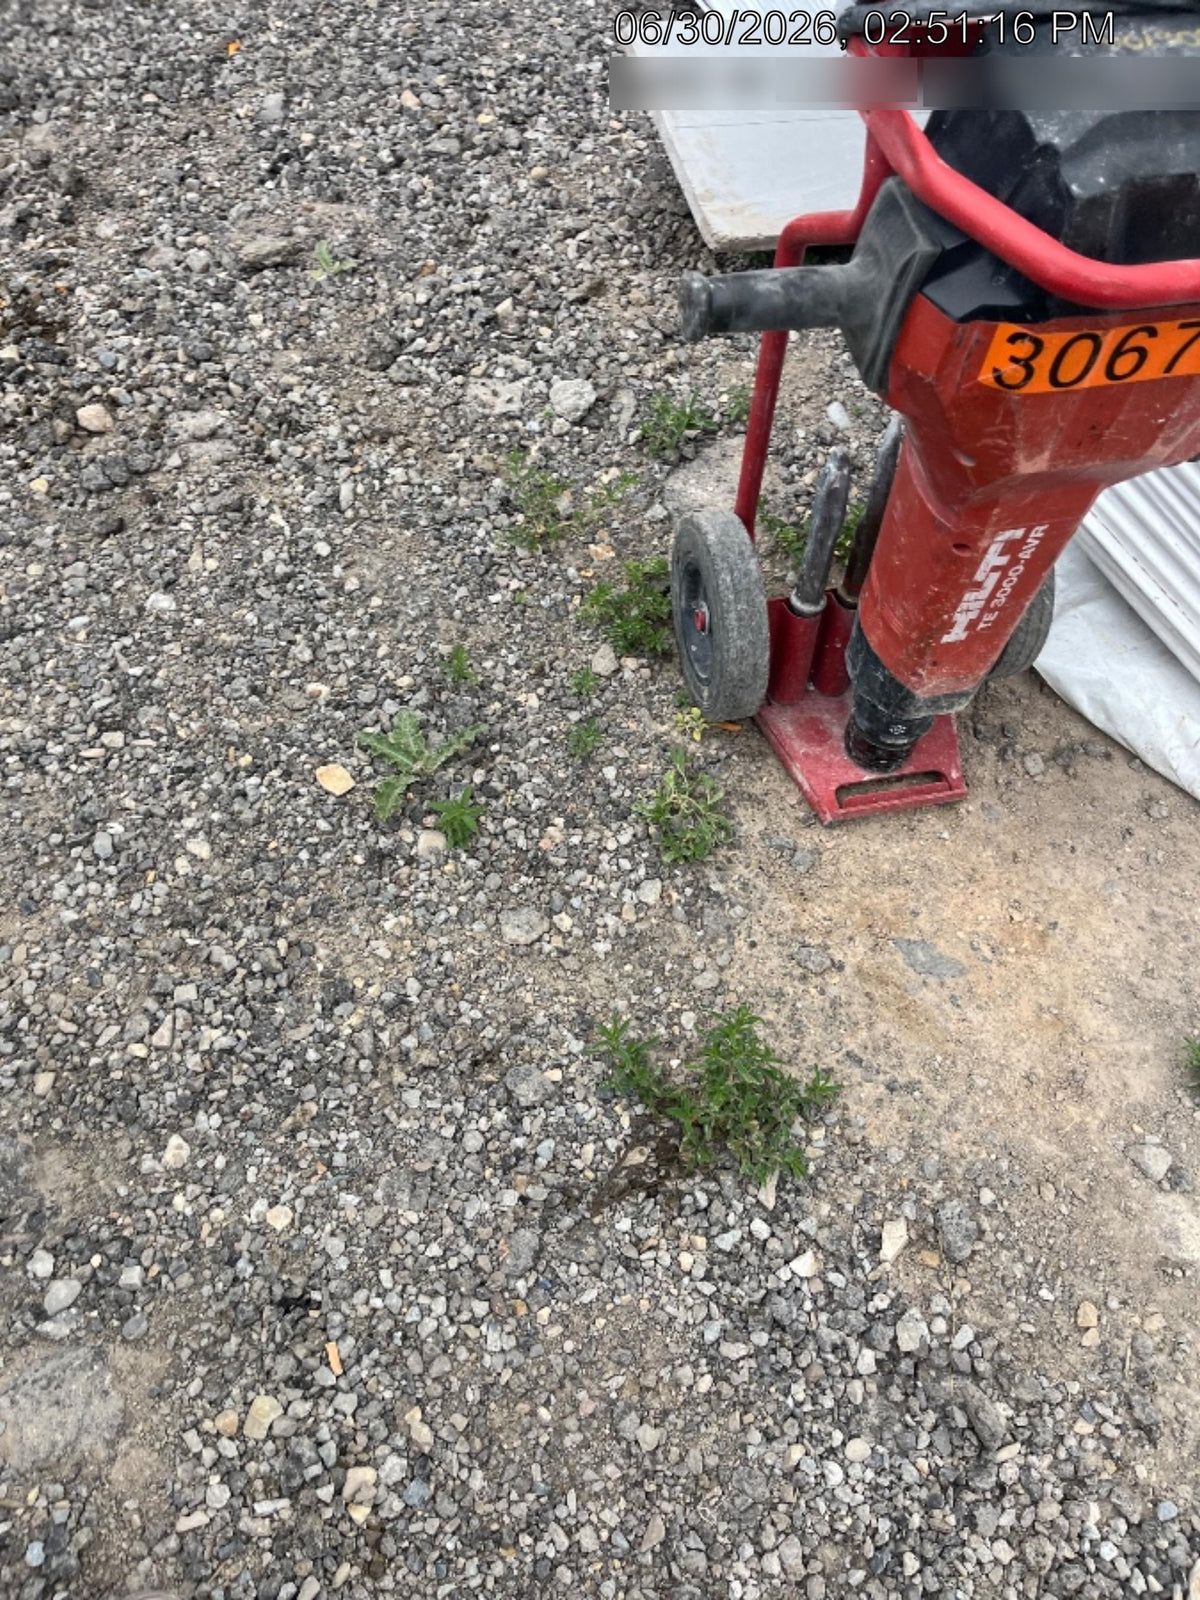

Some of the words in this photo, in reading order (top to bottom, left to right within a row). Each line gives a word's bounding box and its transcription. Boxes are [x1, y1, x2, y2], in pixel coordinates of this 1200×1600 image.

[940, 527, 1026, 644] HILTI
[976, 611, 998, 631] TE
[990, 524, 1050, 607] 3000-AVR
